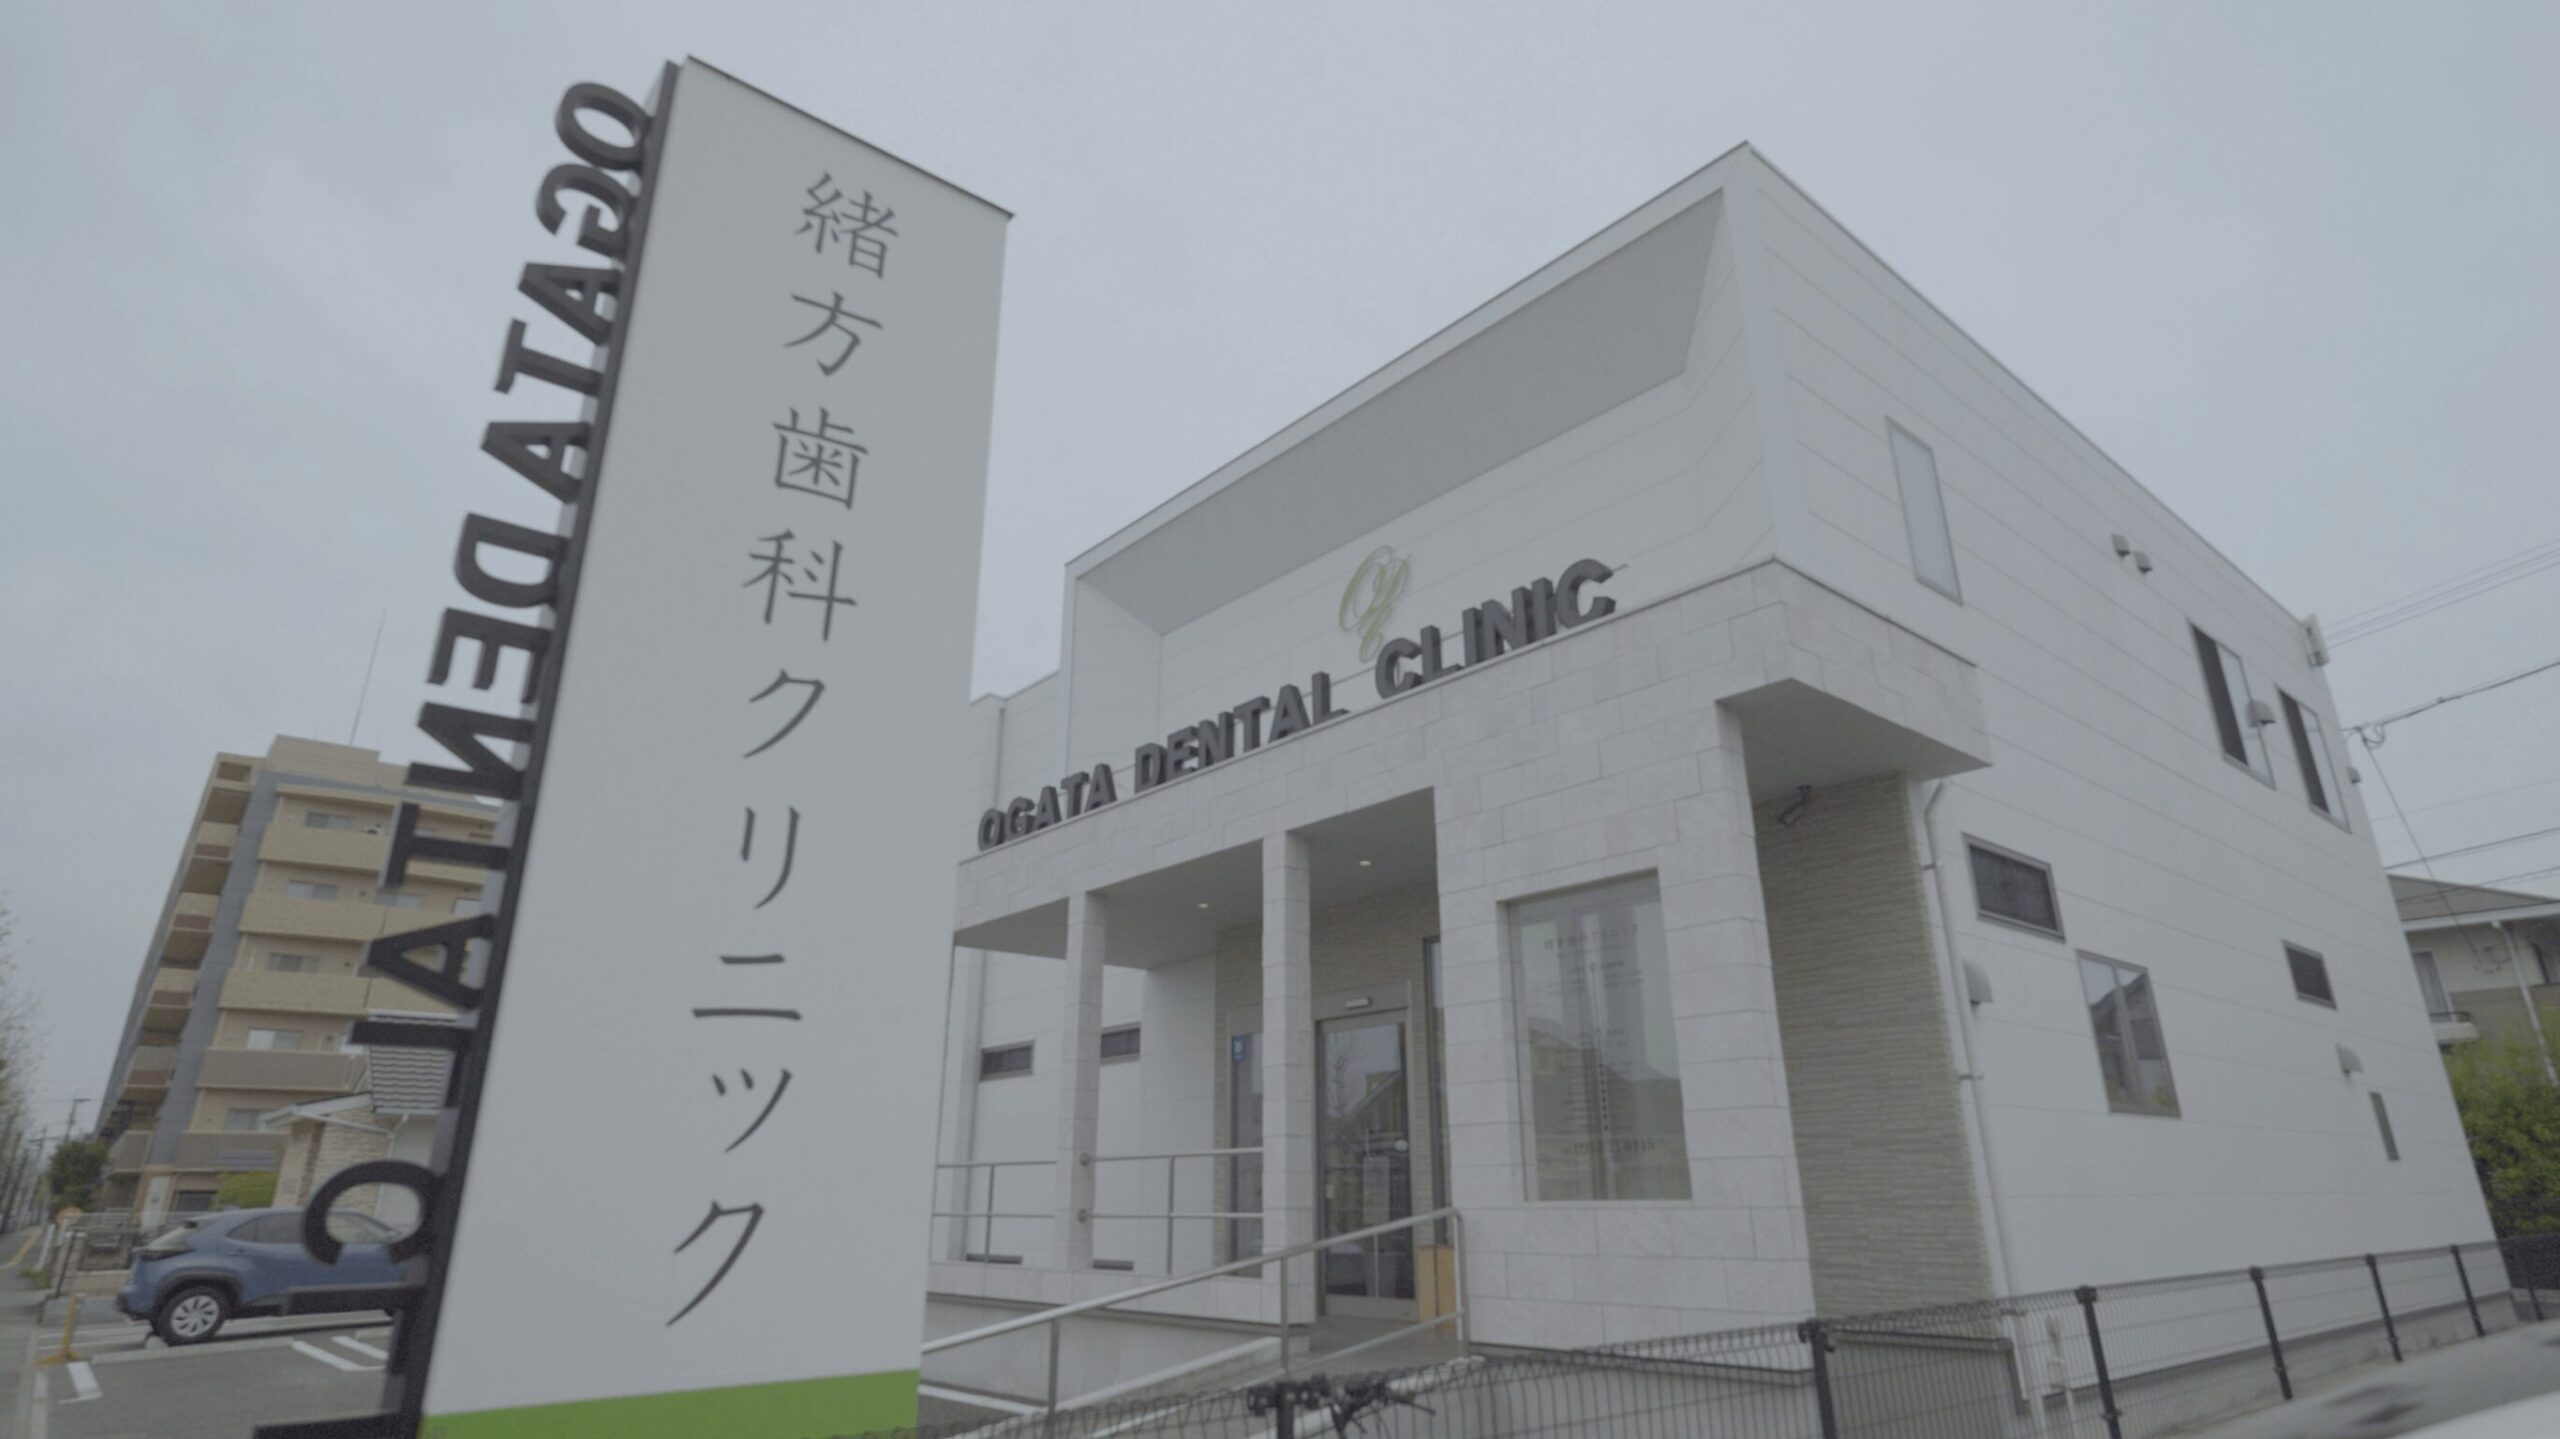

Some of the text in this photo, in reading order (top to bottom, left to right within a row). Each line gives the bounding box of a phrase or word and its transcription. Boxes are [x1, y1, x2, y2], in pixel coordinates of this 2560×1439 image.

[665, 171, 900, 1326] 緒方歯科クリニック
[977, 763, 1118, 852] OGATA
[1135, 671, 1350, 794] DENTAL
[1375, 557, 1617, 700] CLINIC
